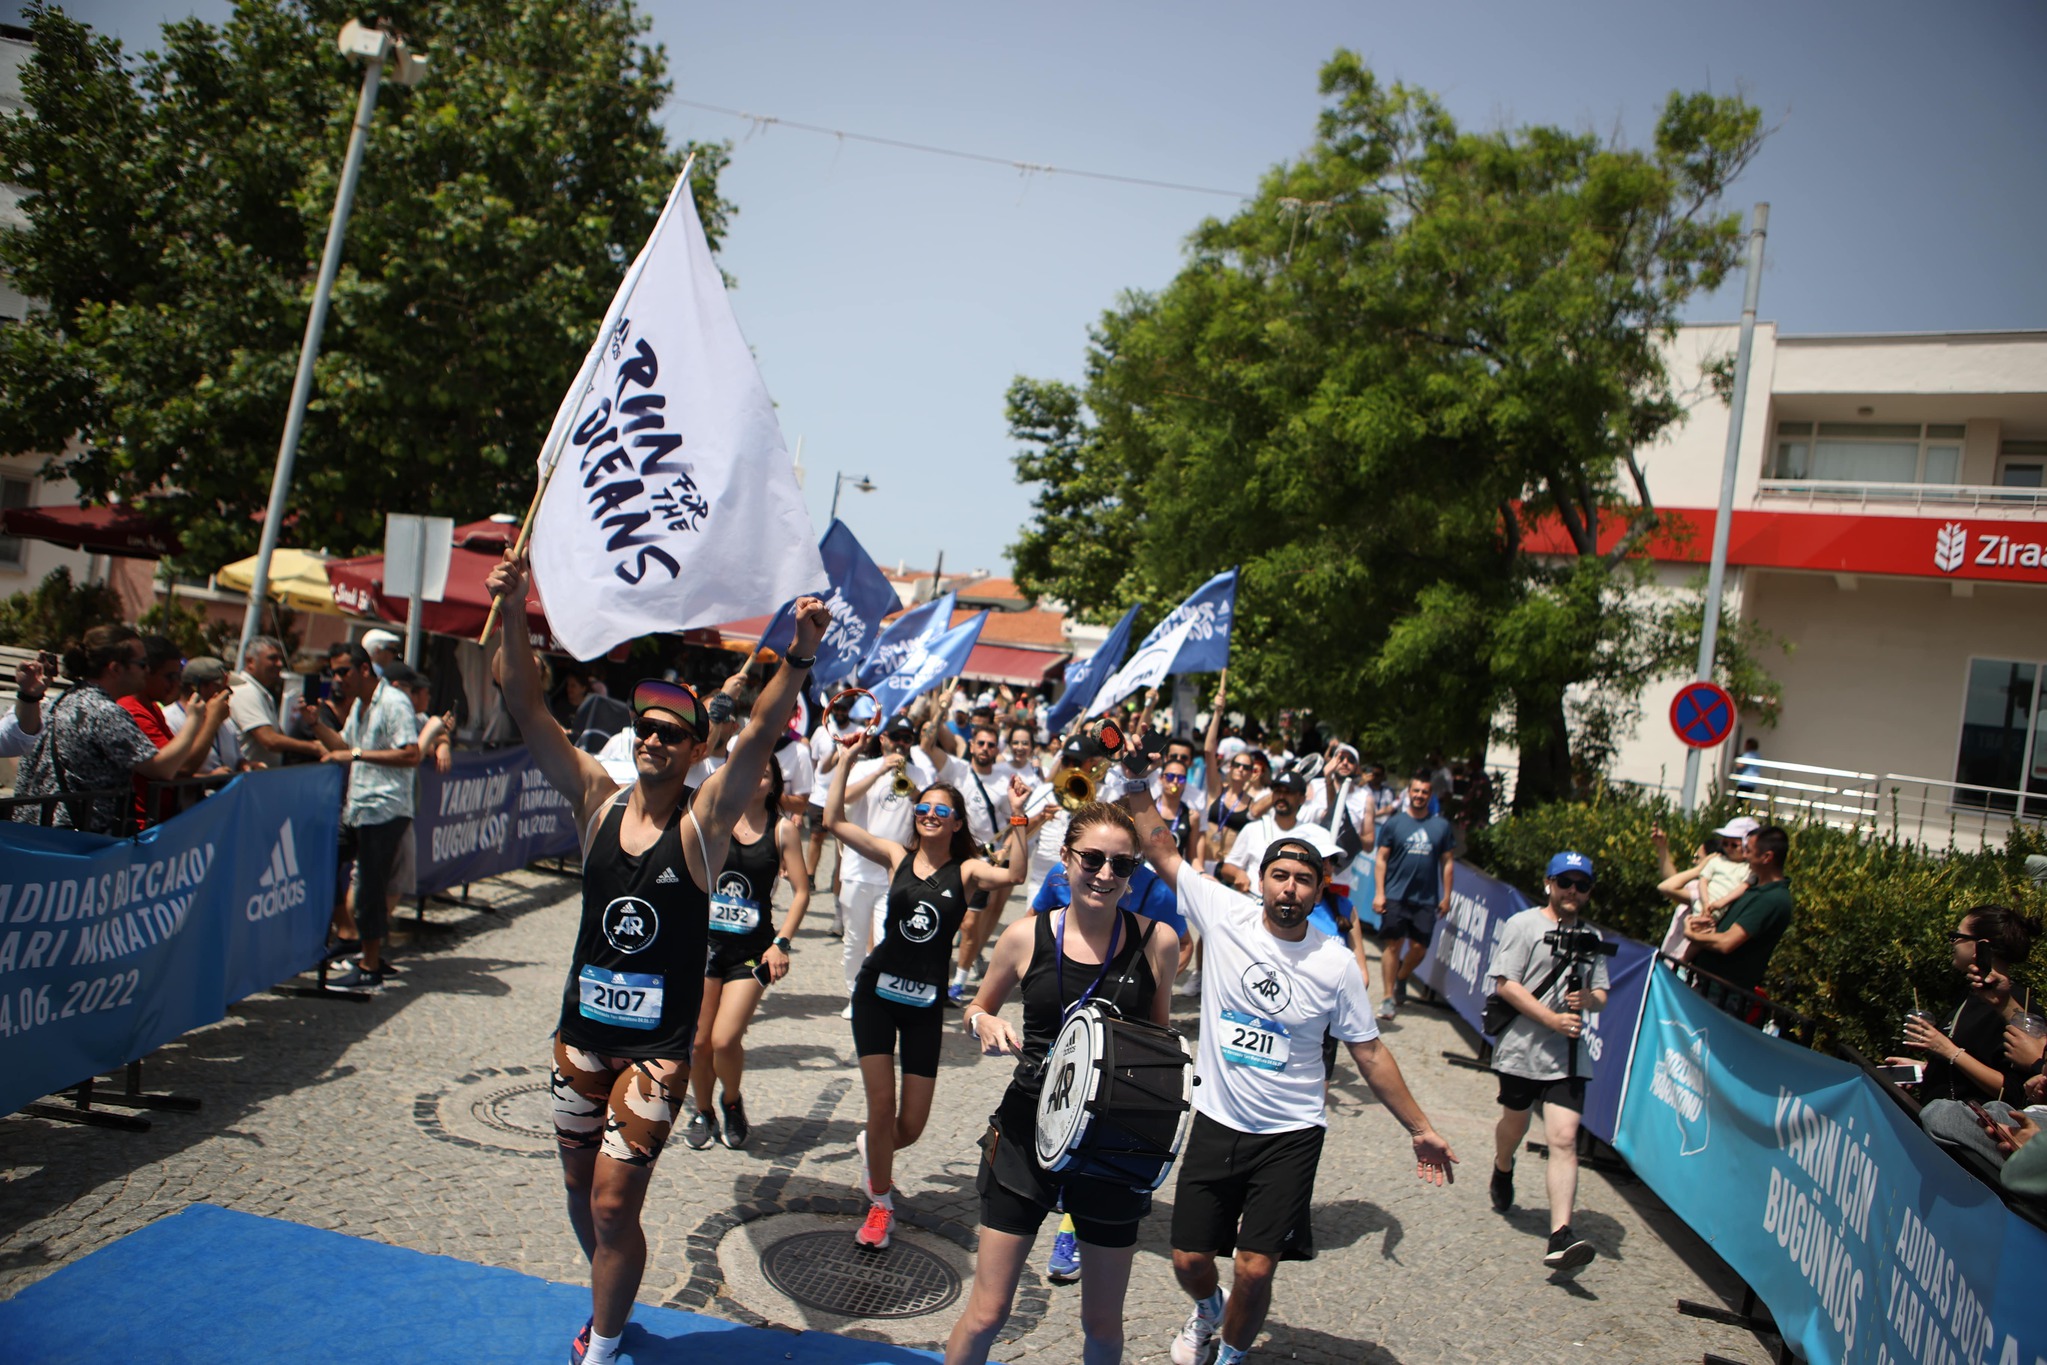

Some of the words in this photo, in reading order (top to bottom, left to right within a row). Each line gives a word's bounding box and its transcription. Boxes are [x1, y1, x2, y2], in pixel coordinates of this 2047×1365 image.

[614, 338, 694, 475] RUN
[572, 397, 681, 585] OCEANS
[651, 487, 690, 531] THE
[672, 472, 708, 532] FOR
[439, 776, 486, 817] YARIN
[246, 877, 306, 922] adidas
[715, 906, 748, 923] 2132
[594, 985, 646, 1011] 2107
[889, 976, 926, 994] 2109
[1232, 1027, 1274, 1054] 2211
[1774, 1085, 1842, 1196] YARIN
[1836, 1116, 1879, 1244] İÇİN
[819, 1260, 908, 1287] TELEFON
[1762, 1166, 1832, 1297] BUGÜN
[1823, 1235, 1864, 1365] KOŞ
[1895, 1206, 1954, 1320] ADIDAS
[1887, 1265, 1925, 1361] YARI
